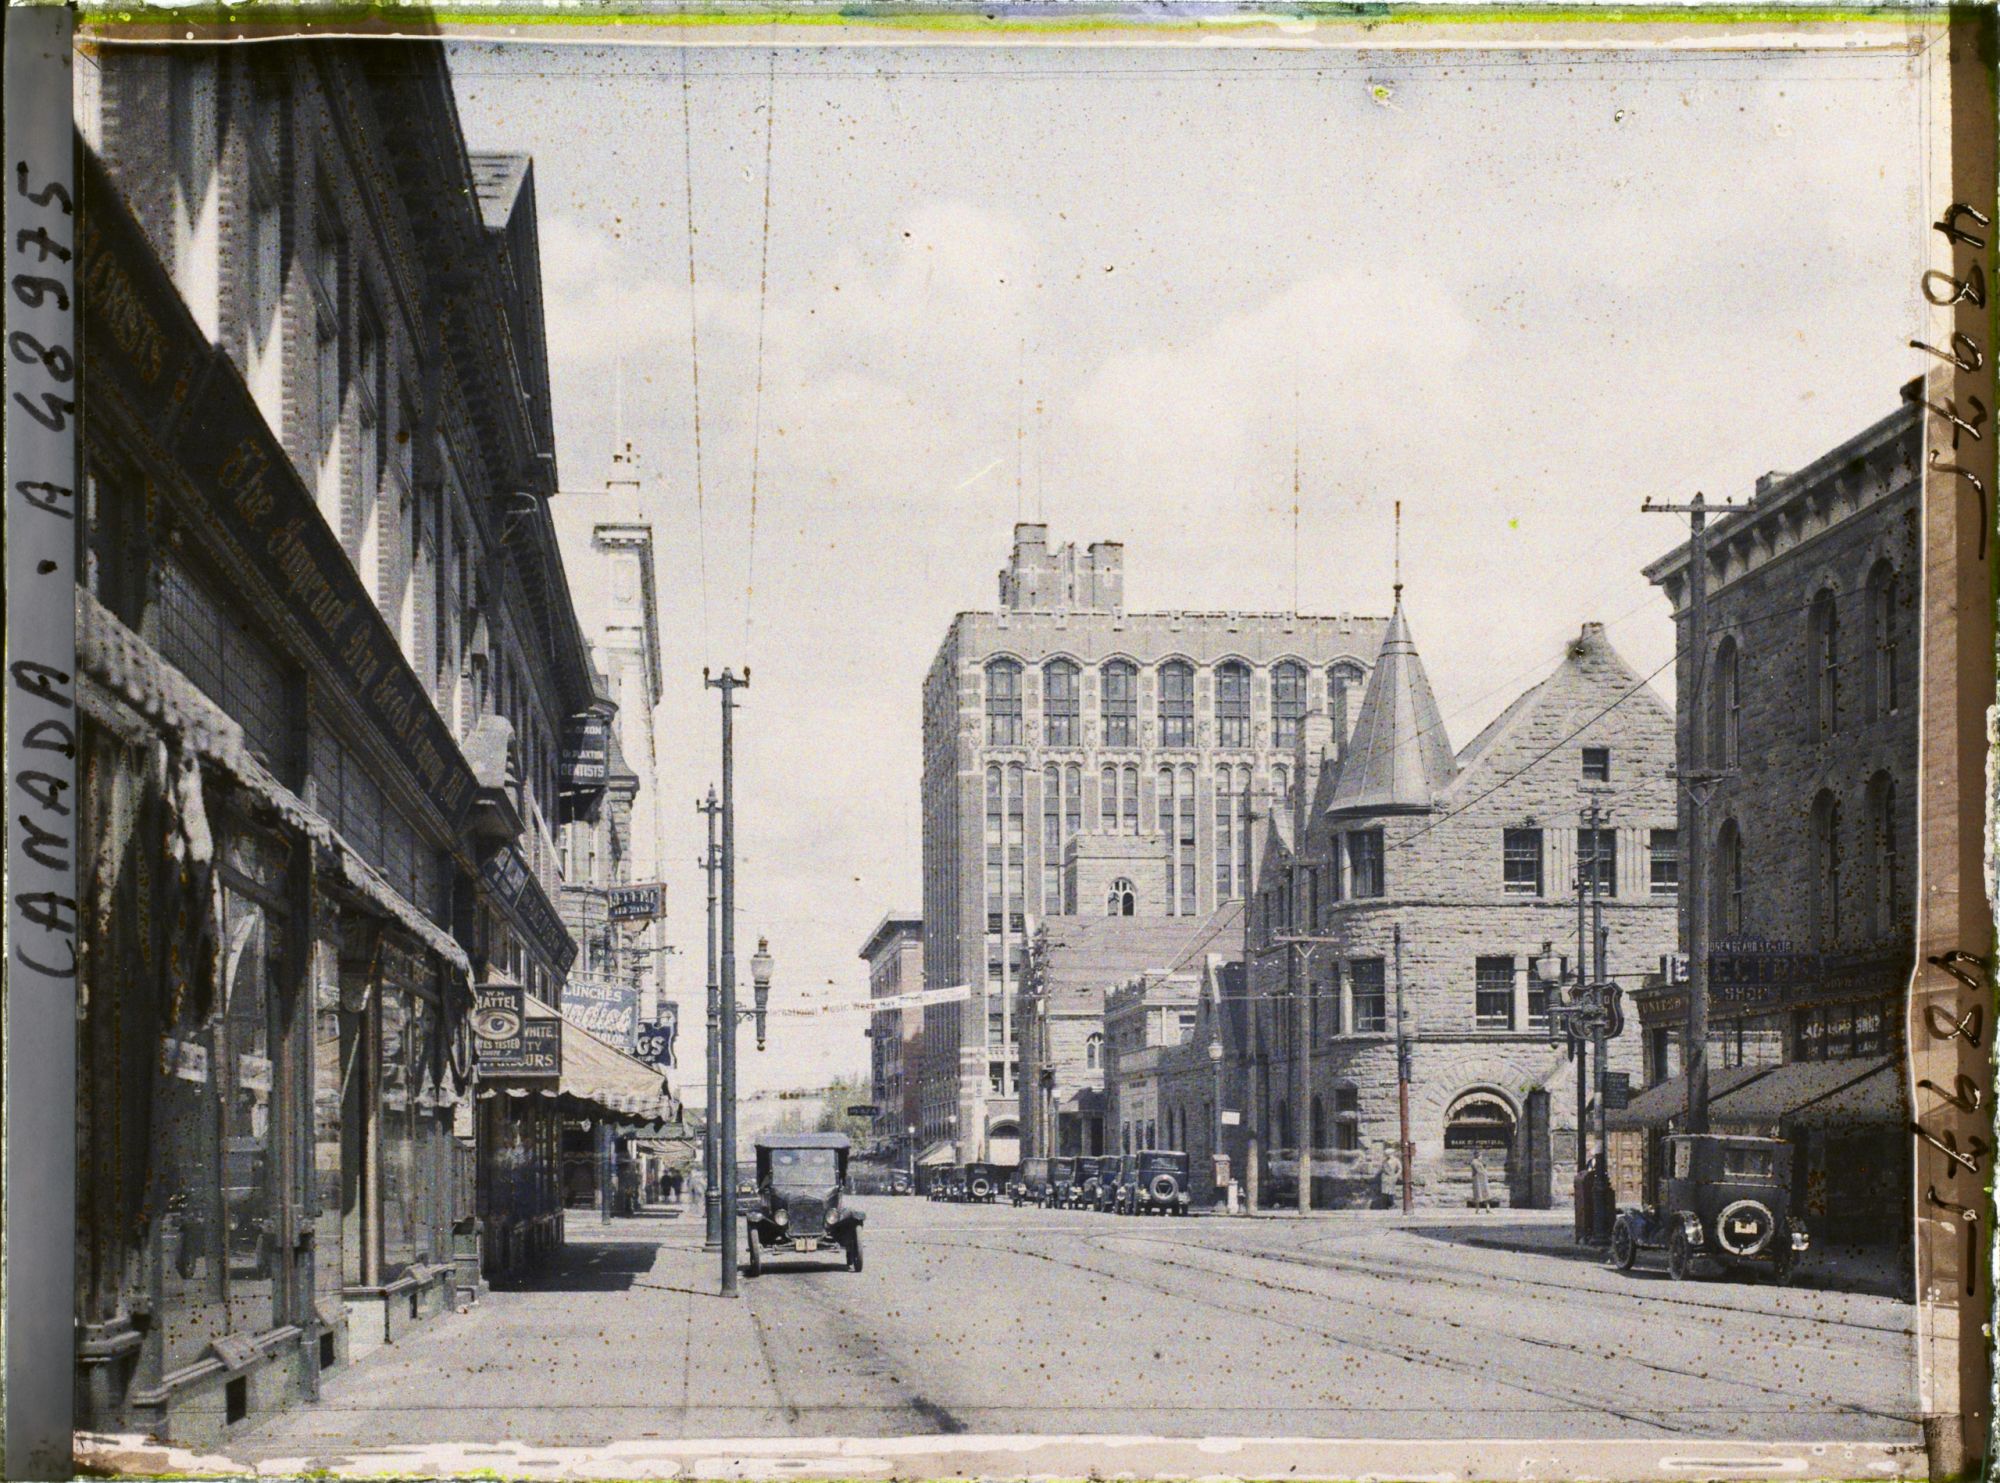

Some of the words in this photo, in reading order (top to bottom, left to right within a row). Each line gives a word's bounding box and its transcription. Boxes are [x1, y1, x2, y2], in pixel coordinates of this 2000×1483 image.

[9, 161, 74, 432] 48975
[560, 763, 605, 777] DENTISTS
[10, 660, 76, 978] CANADA
[562, 983, 623, 1002] LUNCHES
[1723, 986, 1768, 1002] SHOP
[494, 1037, 521, 1050] TESTED
